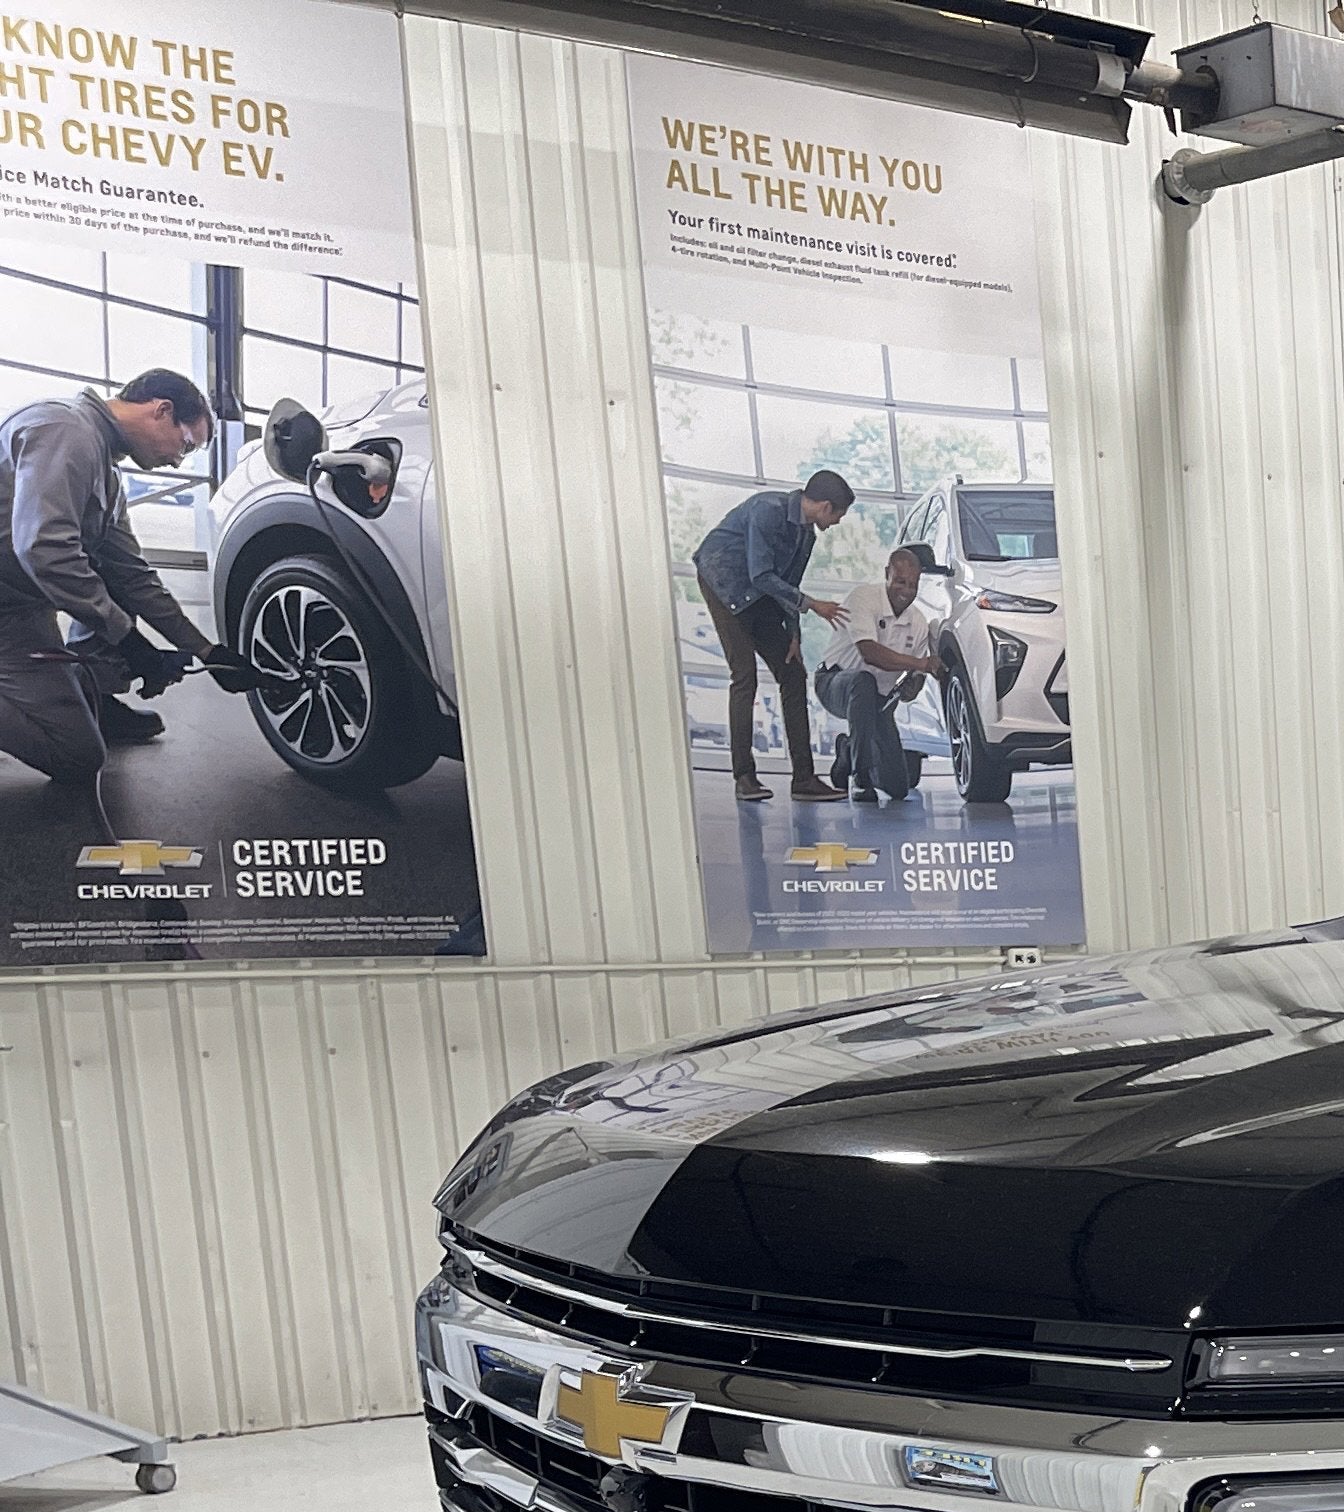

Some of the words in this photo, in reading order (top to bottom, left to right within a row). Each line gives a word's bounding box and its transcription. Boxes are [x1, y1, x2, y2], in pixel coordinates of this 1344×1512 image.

[2, 16, 137, 70] KNOW
[152, 39, 235, 86] THE
[69, 73, 195, 124] TIRES
[210, 94, 289, 138] FOR
[61, 119, 206, 171] CHEVY
[222, 140, 283, 182] EV.
[661, 116, 772, 166] WE'RE
[782, 139, 869, 183] WITH
[879, 156, 941, 193] YOU
[33, 170, 92, 193] Match
[100, 179, 203, 208] Guarantee.
[666, 159, 732, 199] ALL
[741, 172, 807, 213] THE
[817, 185, 895, 226] WAY.
[667, 209, 704, 228] Your
[708, 216, 743, 236] first
[747, 227, 842, 252] maintenance
[846, 241, 877, 257] visit
[881, 245, 892, 259] is
[233, 839, 385, 865] CERTIFIED
[901, 841, 1013, 864] CERTIFIED
[78, 884, 212, 898] CHEVROLET
[236, 870, 363, 897] SERVICE
[783, 880, 885, 892] CHEVROLET
[903, 868, 997, 891] SERVICE
